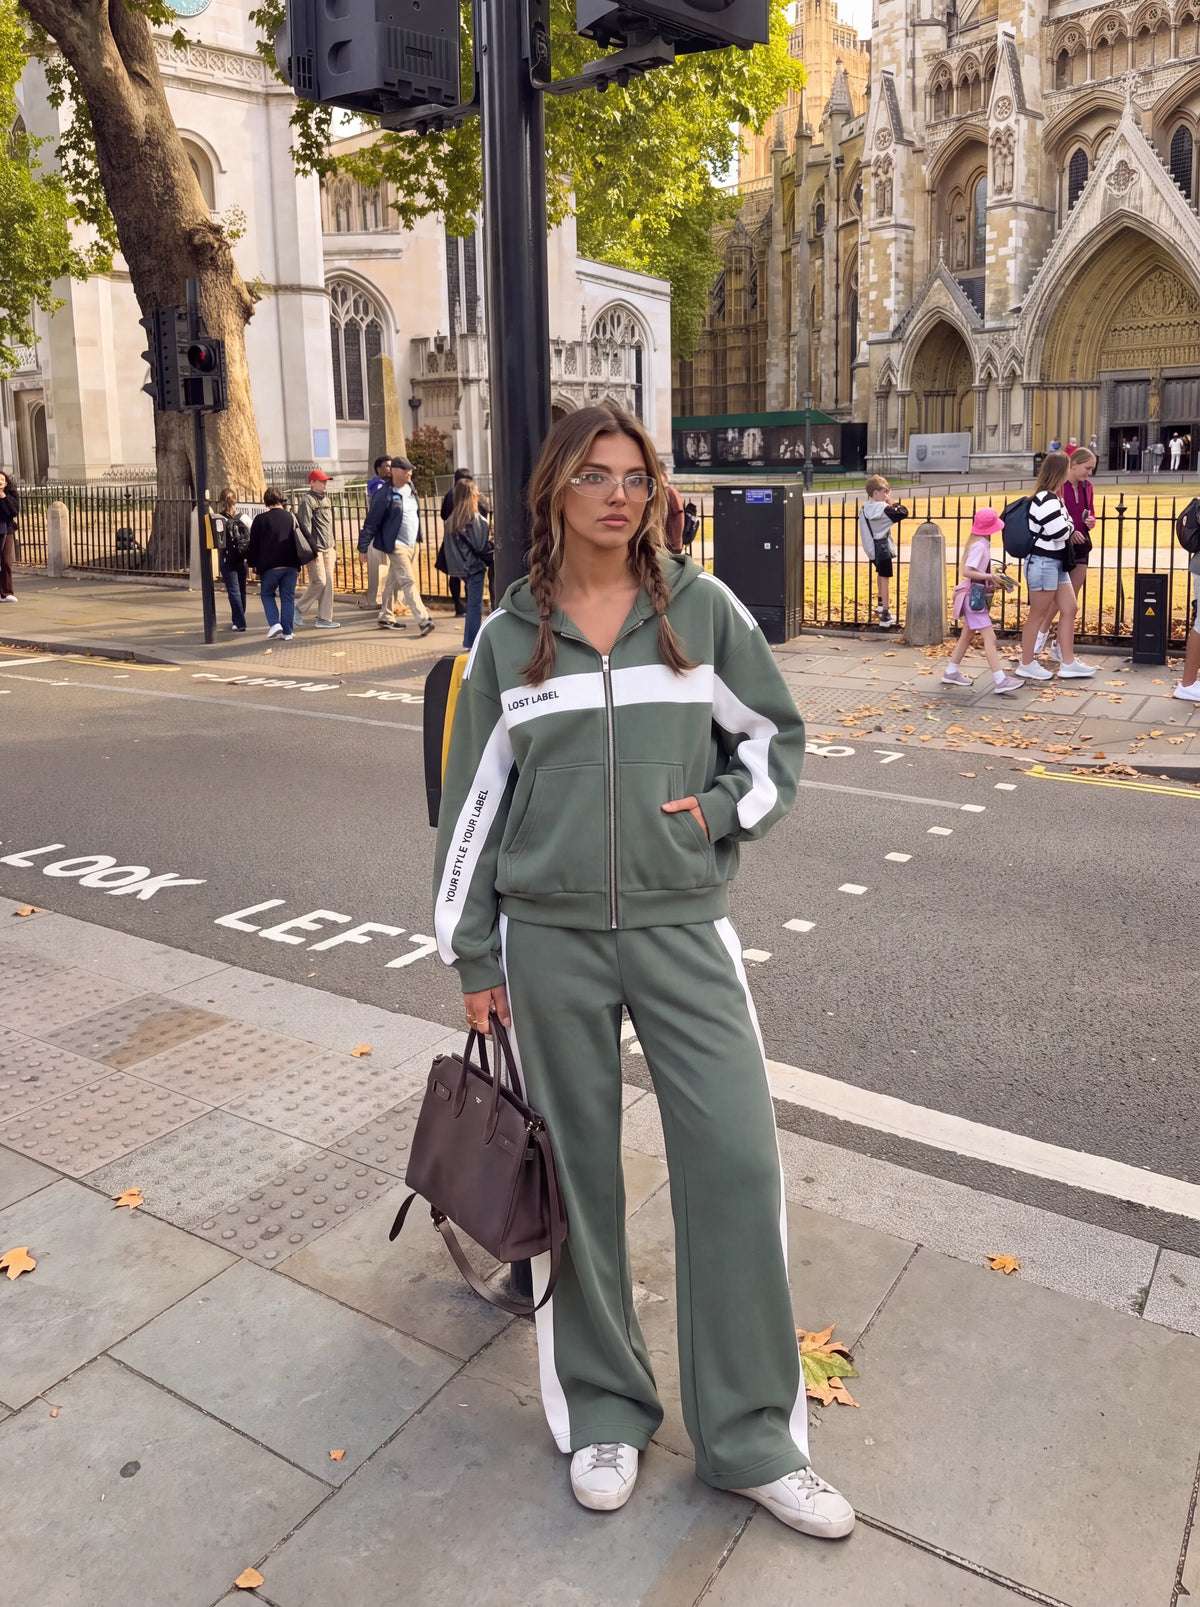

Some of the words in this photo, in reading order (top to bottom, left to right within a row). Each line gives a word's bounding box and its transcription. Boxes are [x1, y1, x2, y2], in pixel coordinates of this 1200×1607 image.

[345, 689, 425, 704] OOK
[507, 697, 530, 712] LOST
[531, 690, 560, 704] LABEL
[471, 789, 489, 818] LABEL
[462, 818, 478, 844] YOUR
[452, 845, 468, 877] STYLE
[445, 877, 460, 903] YOUR
[0, 843, 208, 901] LOOK
[214, 898, 437, 969] LEFT
